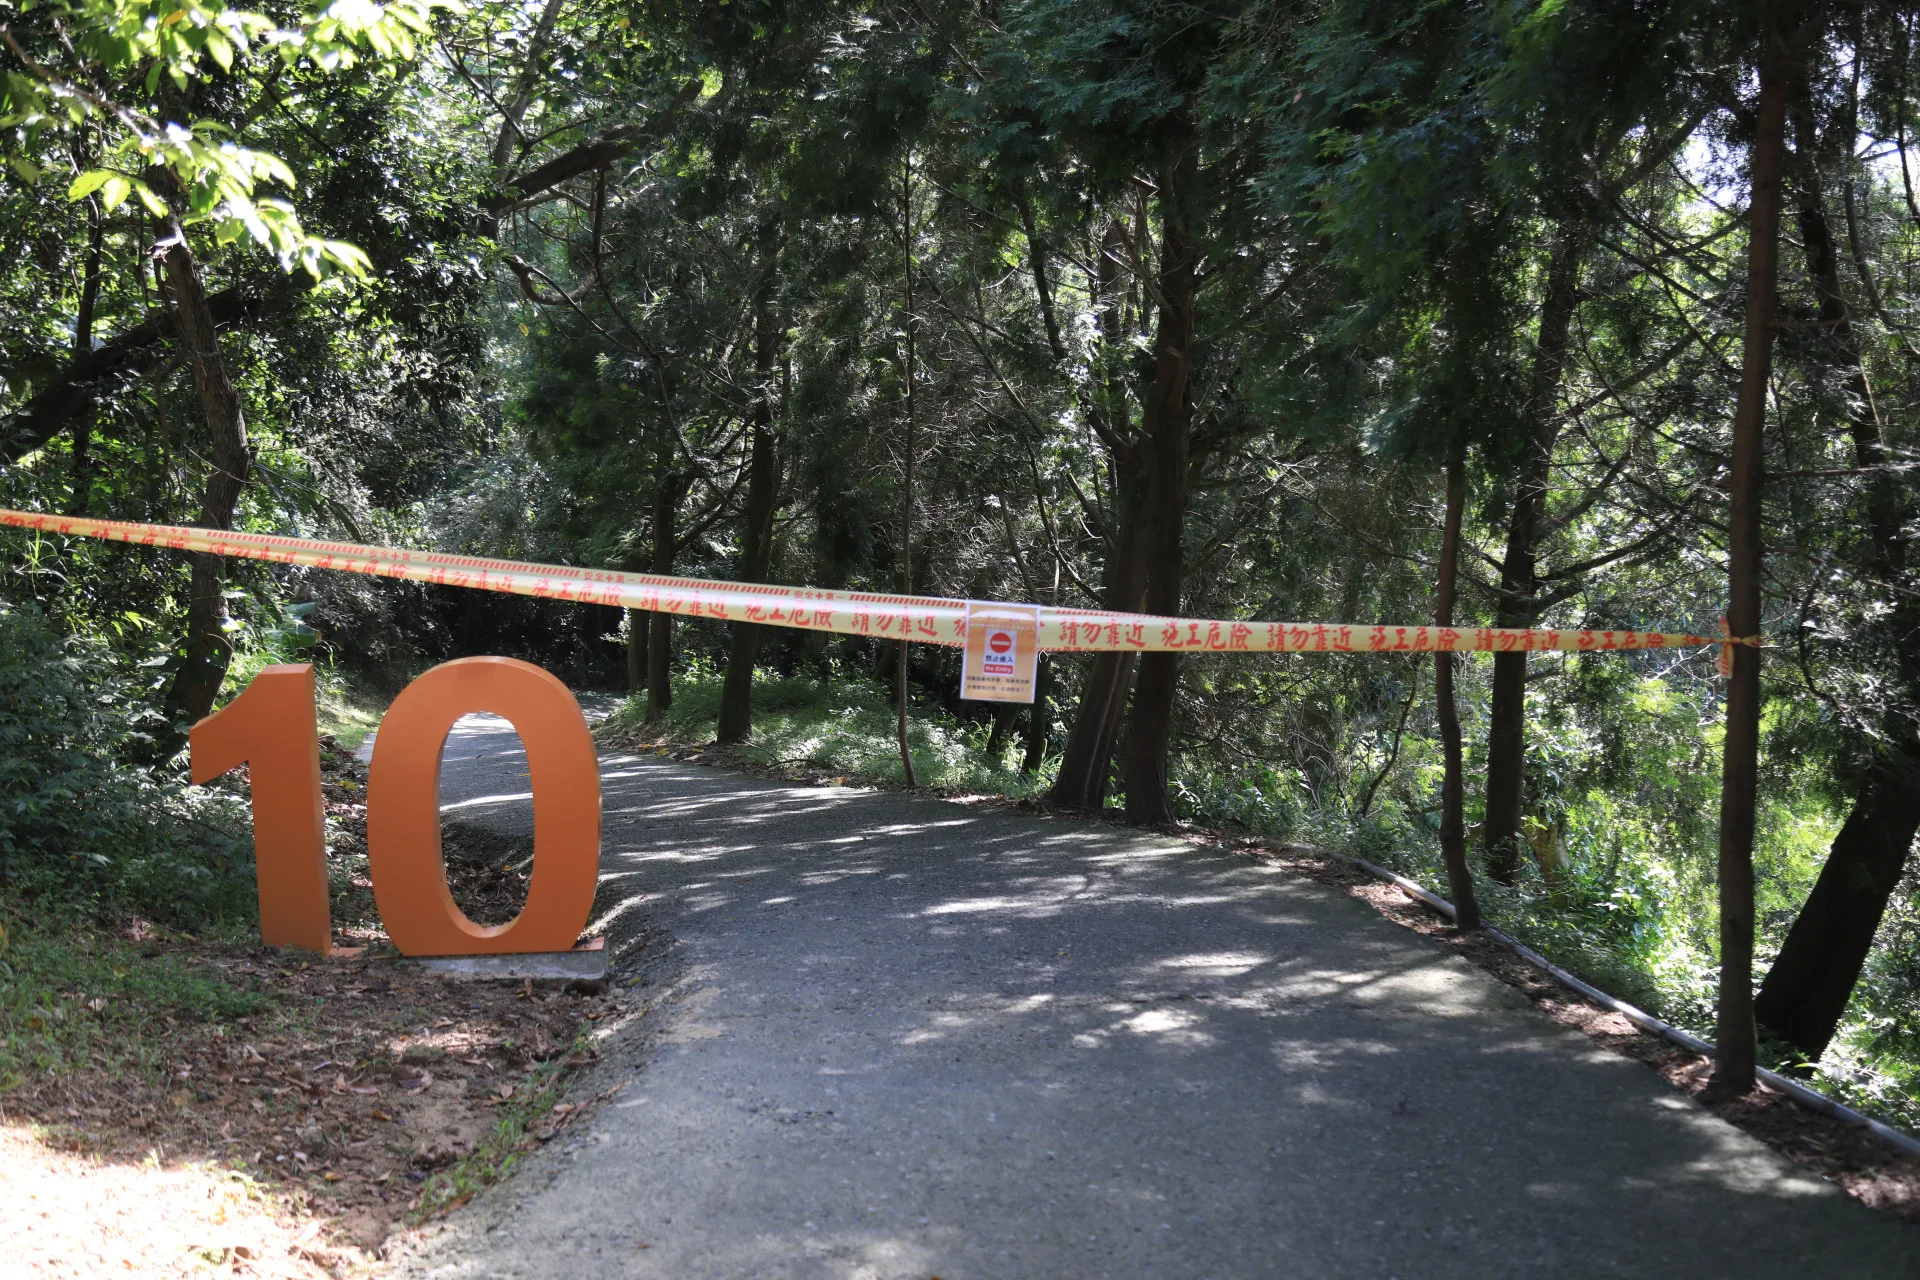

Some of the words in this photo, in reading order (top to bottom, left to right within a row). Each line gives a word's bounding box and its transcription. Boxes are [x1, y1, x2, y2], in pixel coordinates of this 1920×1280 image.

[532, 577, 626, 607] 施工危險
[640, 587, 729, 619] 請勿靠近
[744, 598, 838, 628] 施工危險
[851, 606, 938, 637] 請勿靠近
[1060, 619, 1146, 648] 請勿靠近
[1161, 621, 1253, 650] 施工危險
[1267, 624, 1353, 651] 請勿靠近
[1369, 626, 1461, 651] 施工危險
[1475, 628, 1560, 651] 請勿靠近
[1578, 630, 1665, 649] 施工危險
[189, 655, 601, 956] 10
